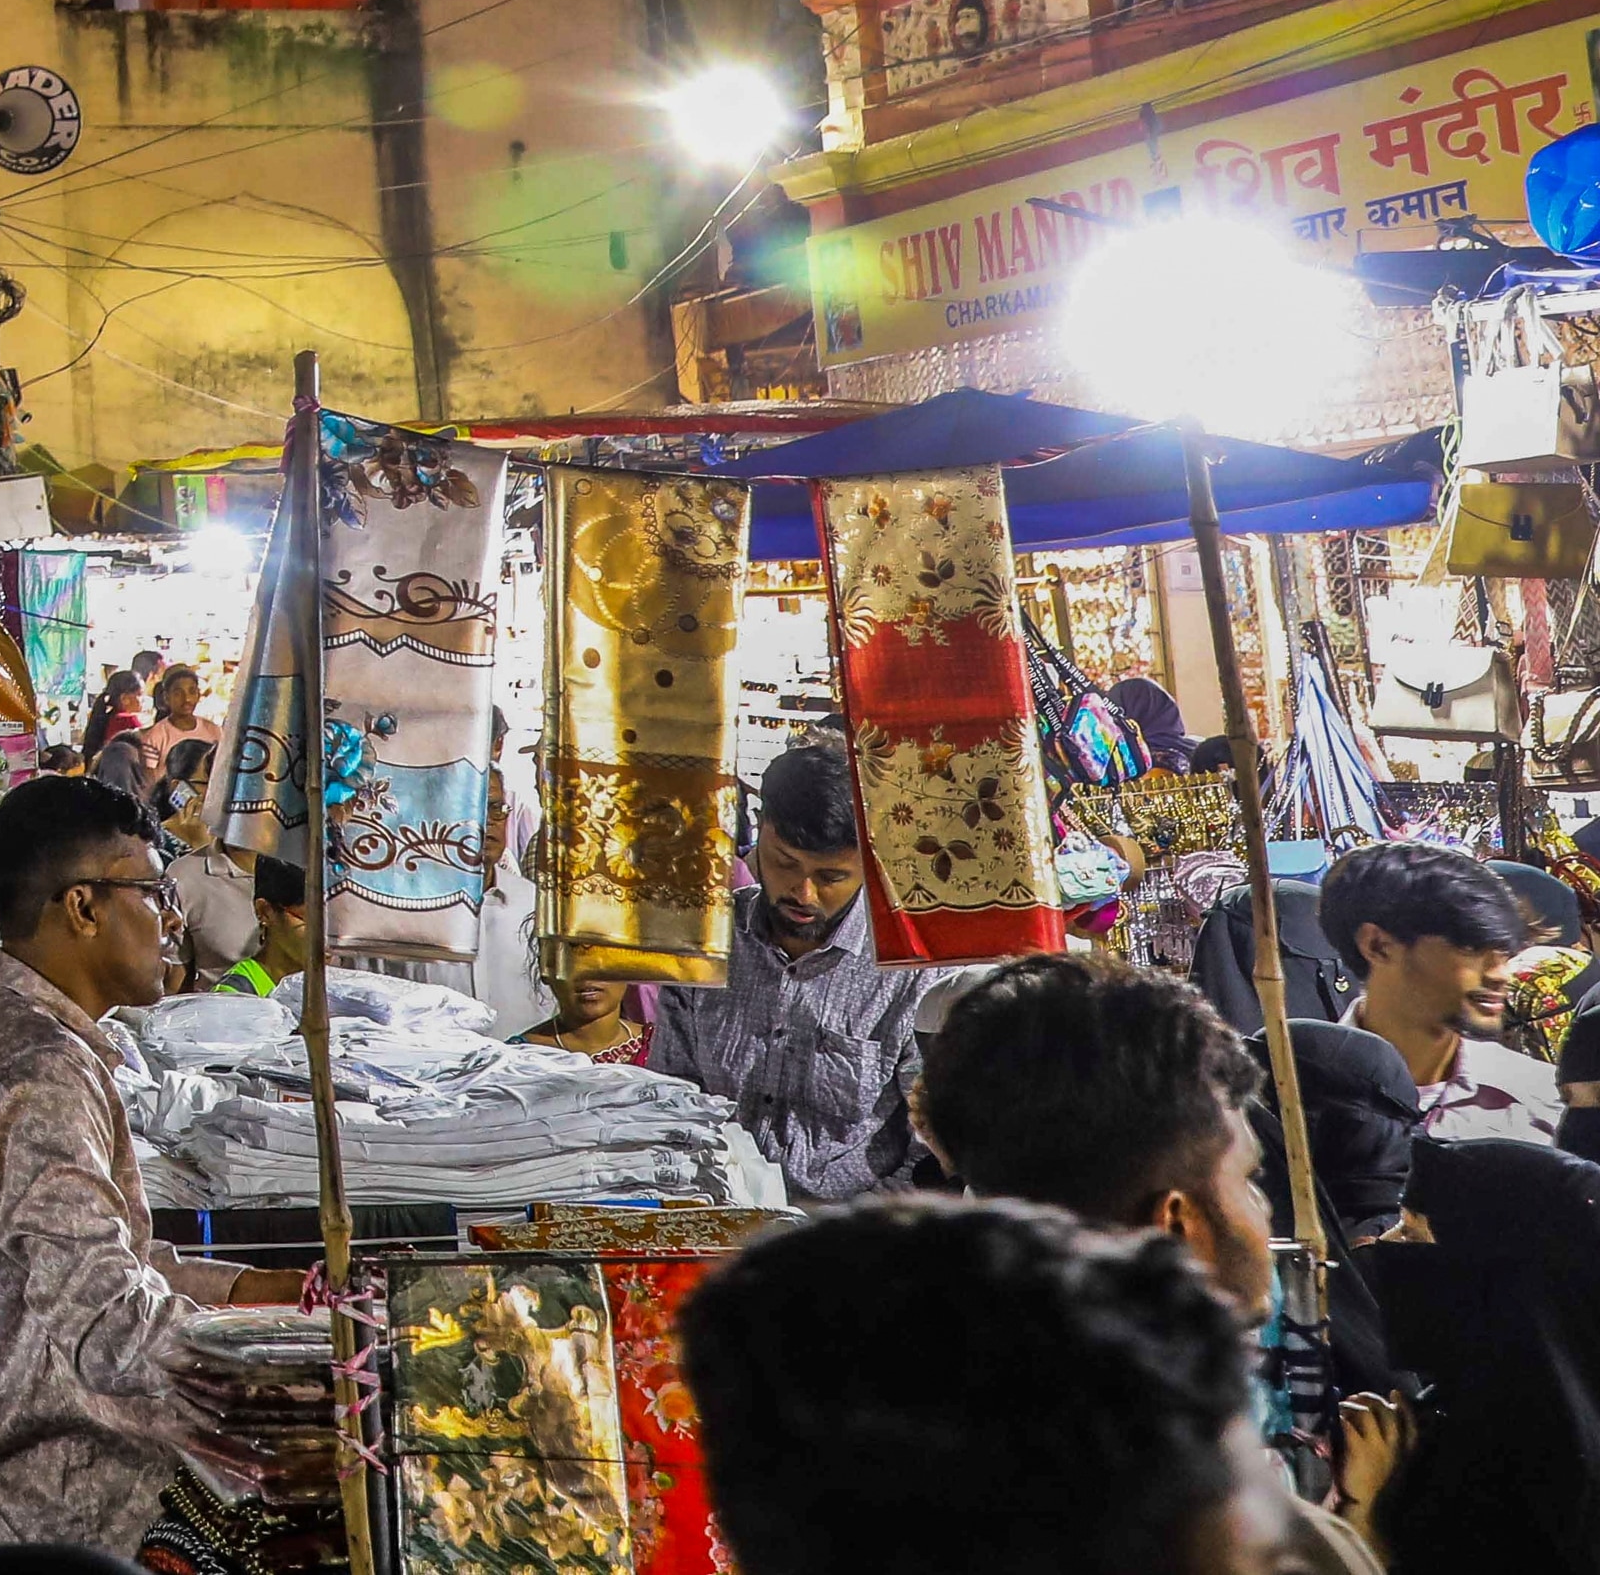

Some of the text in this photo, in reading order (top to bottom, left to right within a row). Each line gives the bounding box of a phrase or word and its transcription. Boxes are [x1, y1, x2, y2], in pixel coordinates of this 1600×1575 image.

[1365, 180, 1468, 228] कमान
[880, 222, 961, 306] SHIV
[1026, 661, 1048, 702] FOREVER
[1042, 701, 1062, 732] YOUNG
[1054, 651, 1092, 688] FOREVER
